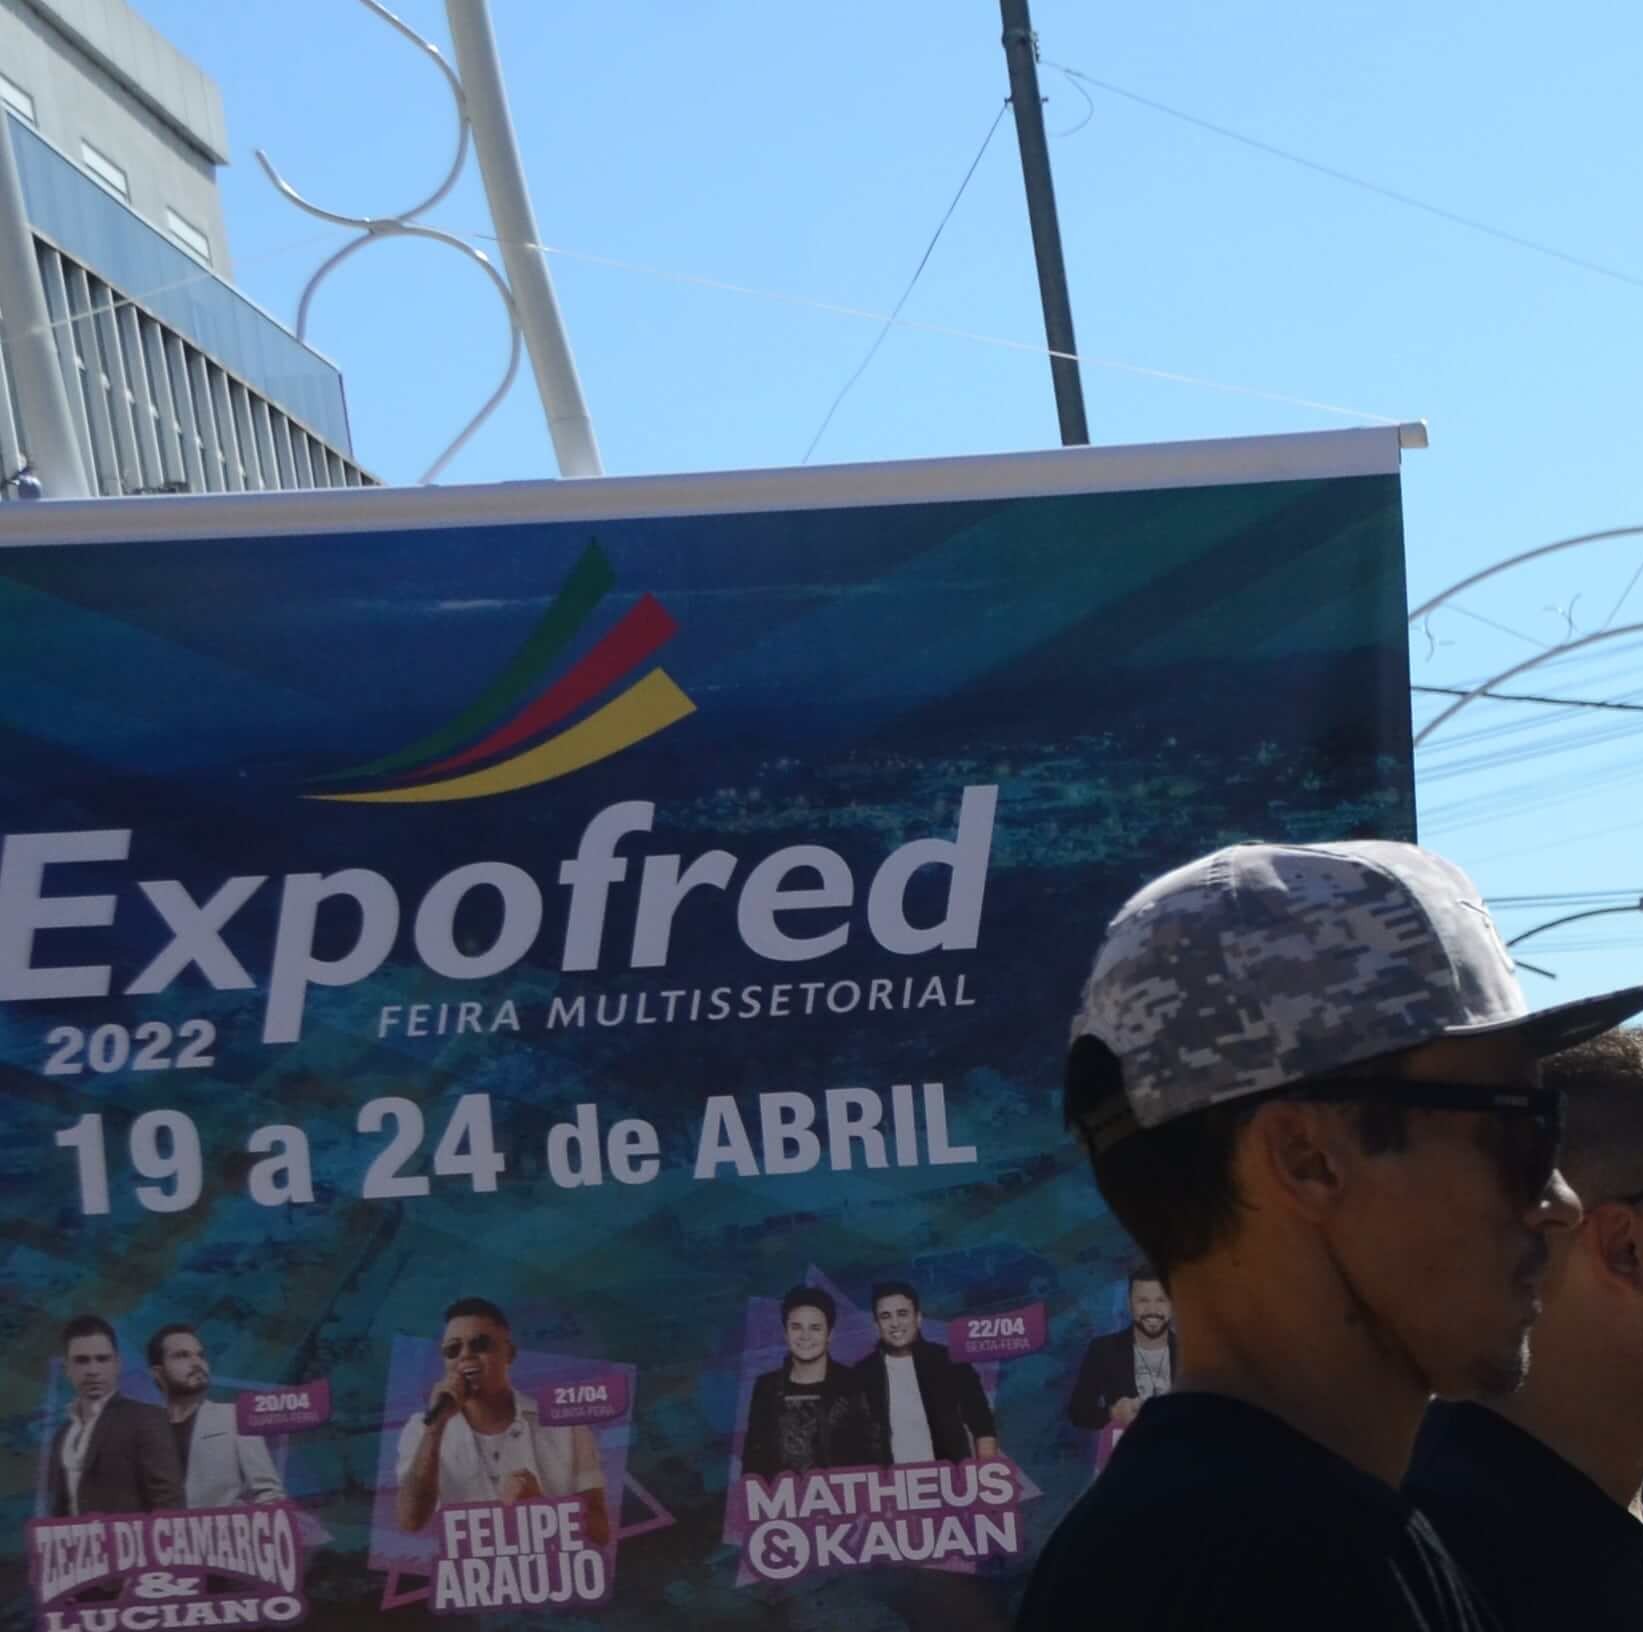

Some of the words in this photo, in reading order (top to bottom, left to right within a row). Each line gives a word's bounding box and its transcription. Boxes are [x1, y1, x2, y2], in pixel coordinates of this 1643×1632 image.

[0, 783, 999, 1044] Expofred
[378, 1004, 521, 1040] FEIRA
[546, 974, 977, 1031] MULTISSETORIAL
[42, 1019, 216, 1077] 2022
[54, 1109, 201, 1216] 19
[247, 1120, 315, 1206] a
[356, 1093, 504, 1199] 24
[547, 1103, 661, 1188] de
[692, 1083, 978, 1180] ABRIL
[967, 1317, 1024, 1338] 22/04
[553, 1385, 608, 1404] 21/04
[744, 1462, 1015, 1521] MATHEUS
[113, 1519, 148, 1571] DI
[152, 1508, 297, 1593] CAMARGO
[443, 1502, 584, 1560] FELIPE
[815, 1511, 1018, 1567] KAUAN
[135, 1571, 200, 1600] &
